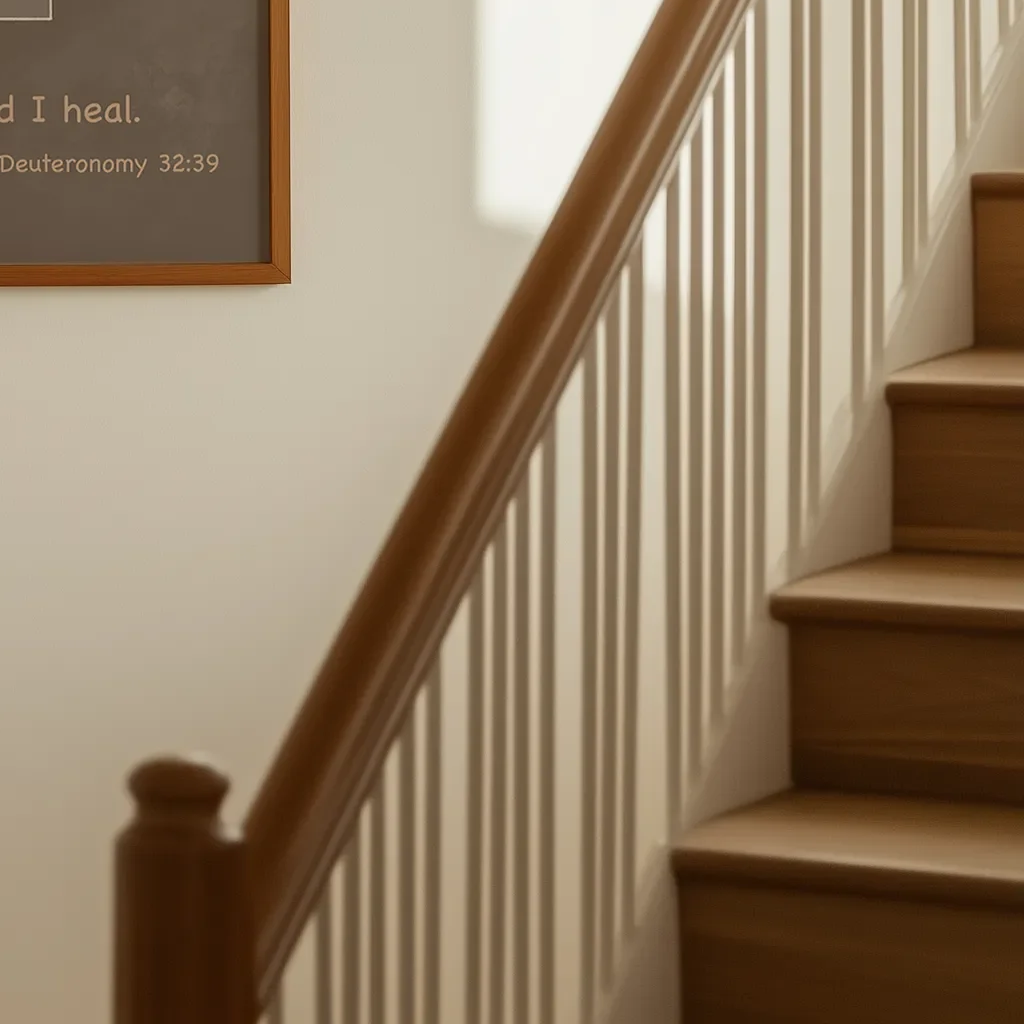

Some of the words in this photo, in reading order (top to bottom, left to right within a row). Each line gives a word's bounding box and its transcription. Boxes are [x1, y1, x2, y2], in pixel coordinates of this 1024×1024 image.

[31, 95, 46, 123] I
[63, 94, 141, 125] heal.
[159, 153, 220, 173] 32:39
